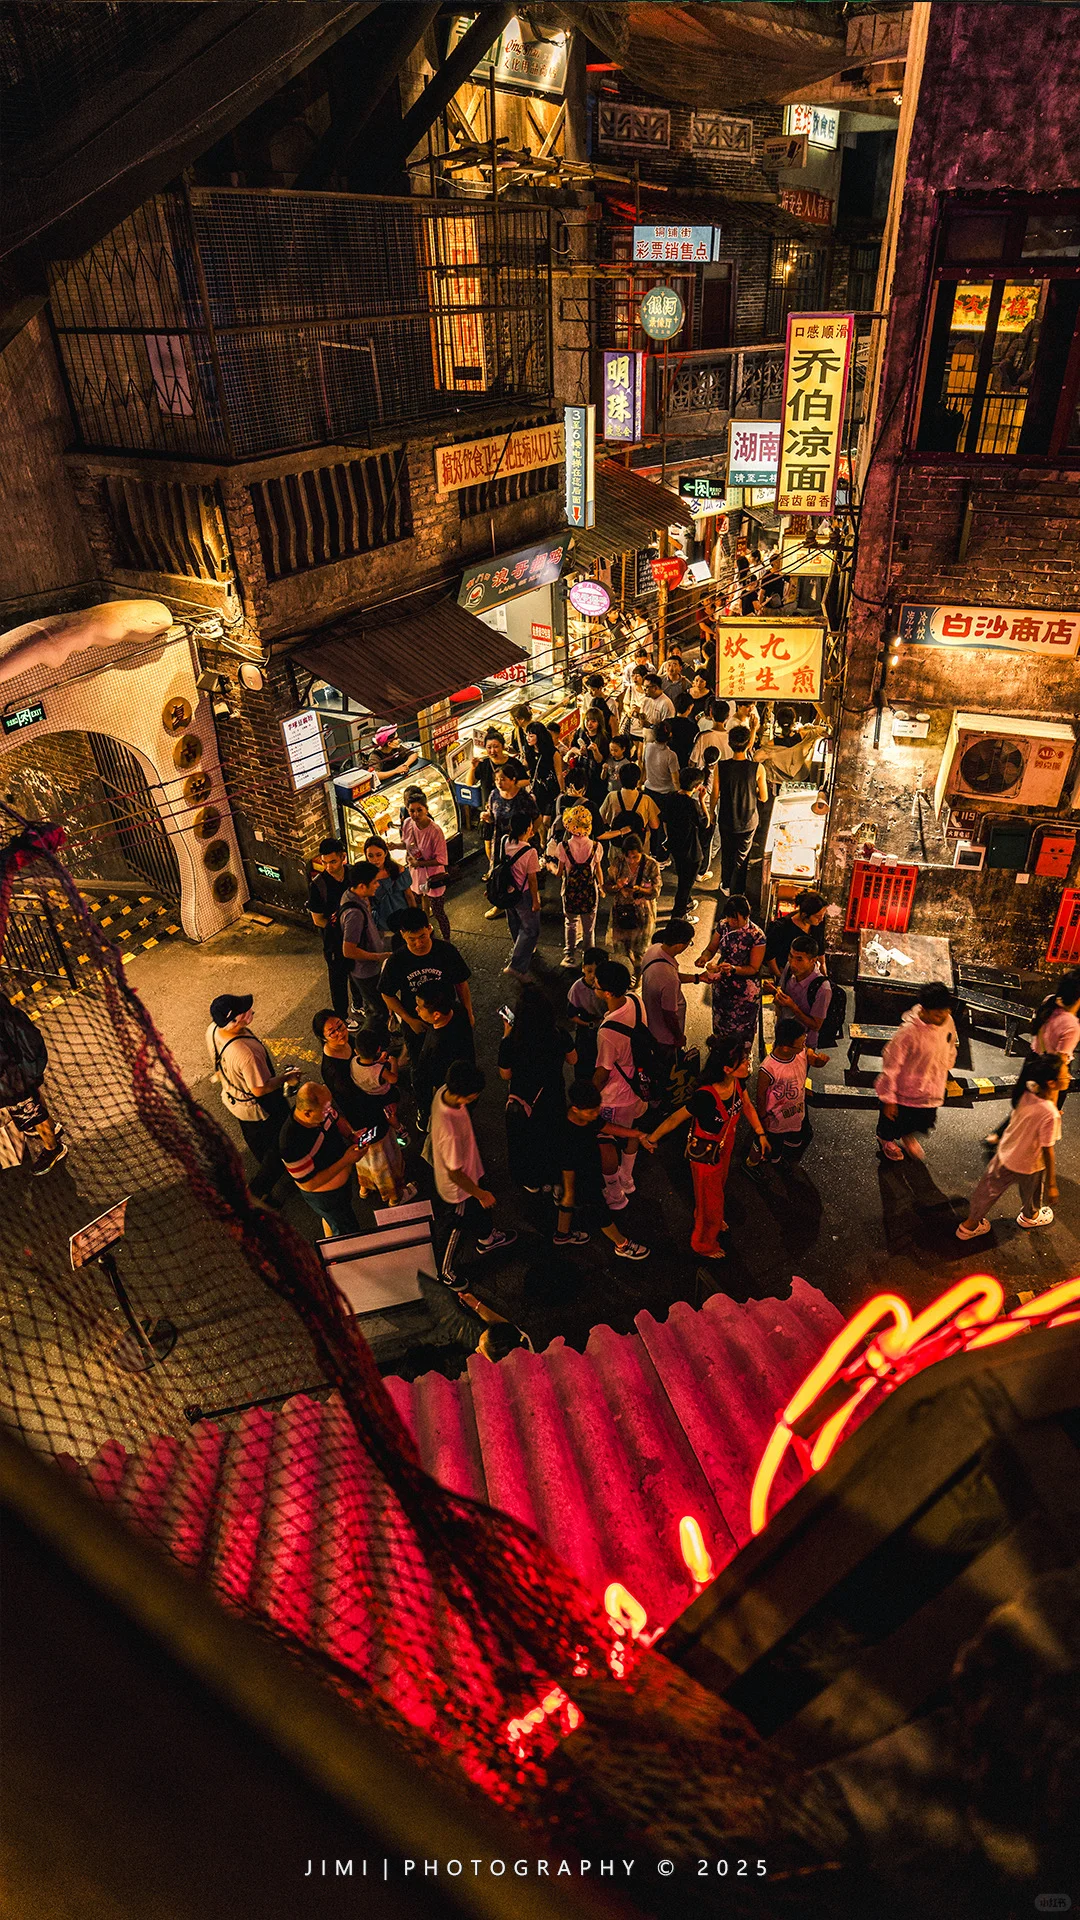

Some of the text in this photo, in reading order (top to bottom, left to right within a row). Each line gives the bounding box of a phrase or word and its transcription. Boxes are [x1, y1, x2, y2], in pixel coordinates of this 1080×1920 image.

[636, 241, 708, 260] 彩票销售点
[646, 296, 677, 315] 银河
[796, 324, 848, 339] 口感顺滑
[606, 355, 632, 423] 明珠
[785, 348, 841, 493] 乔伯凉面
[778, 495, 830, 507] 唇齿留香
[942, 613, 1076, 645] 白沙商店
[756, 665, 815, 694] 生煎
[961, 811, 976, 821] 119
[773, 1081, 799, 1100] 95
